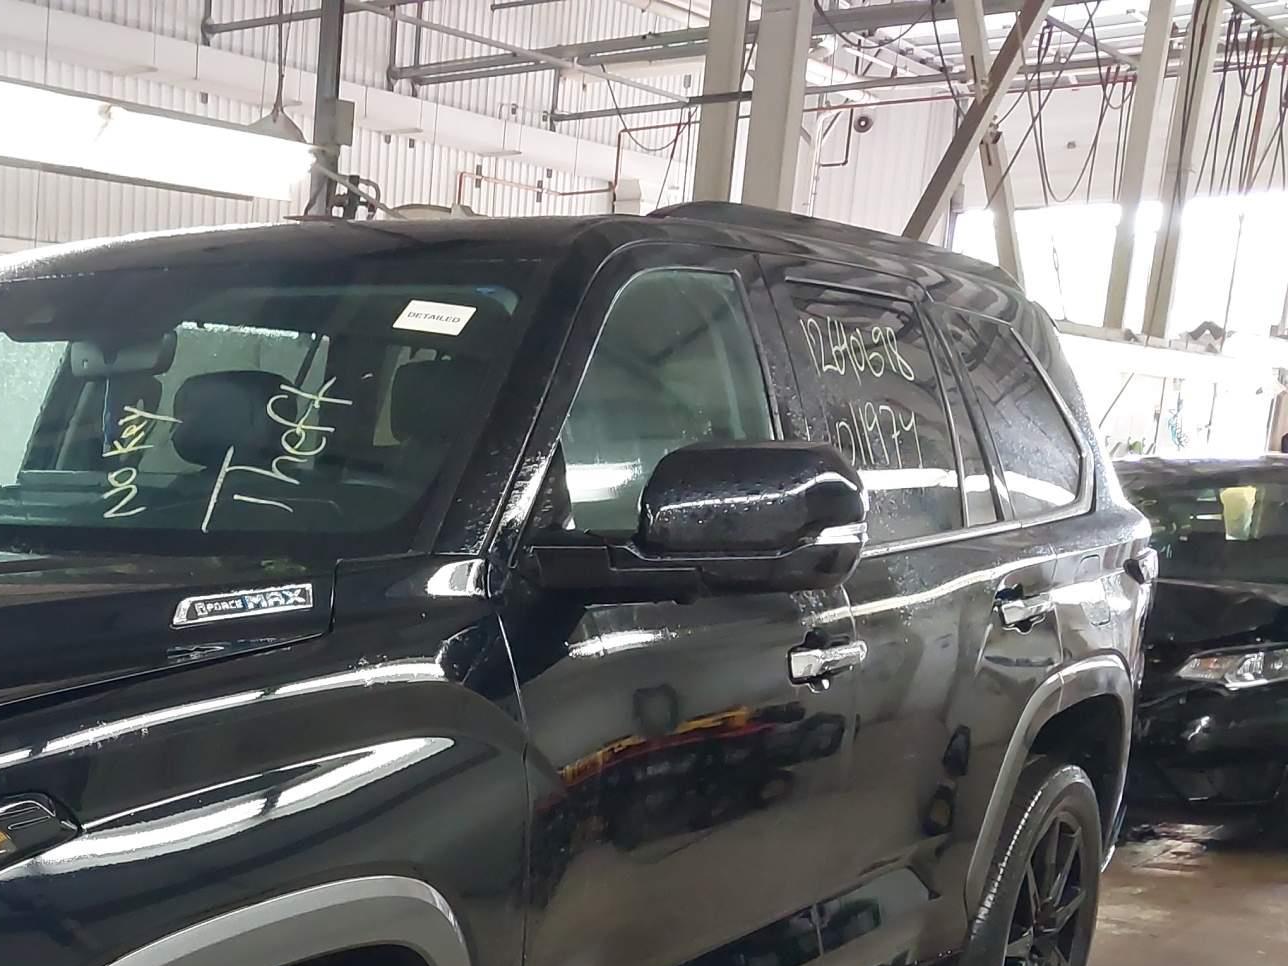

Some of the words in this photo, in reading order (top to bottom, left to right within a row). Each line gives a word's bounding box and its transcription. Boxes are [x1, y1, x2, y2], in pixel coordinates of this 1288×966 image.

[406, 310, 462, 324] DETAILED
[200, 376, 353, 533] Theft
[244, 588, 306, 610] MAX
